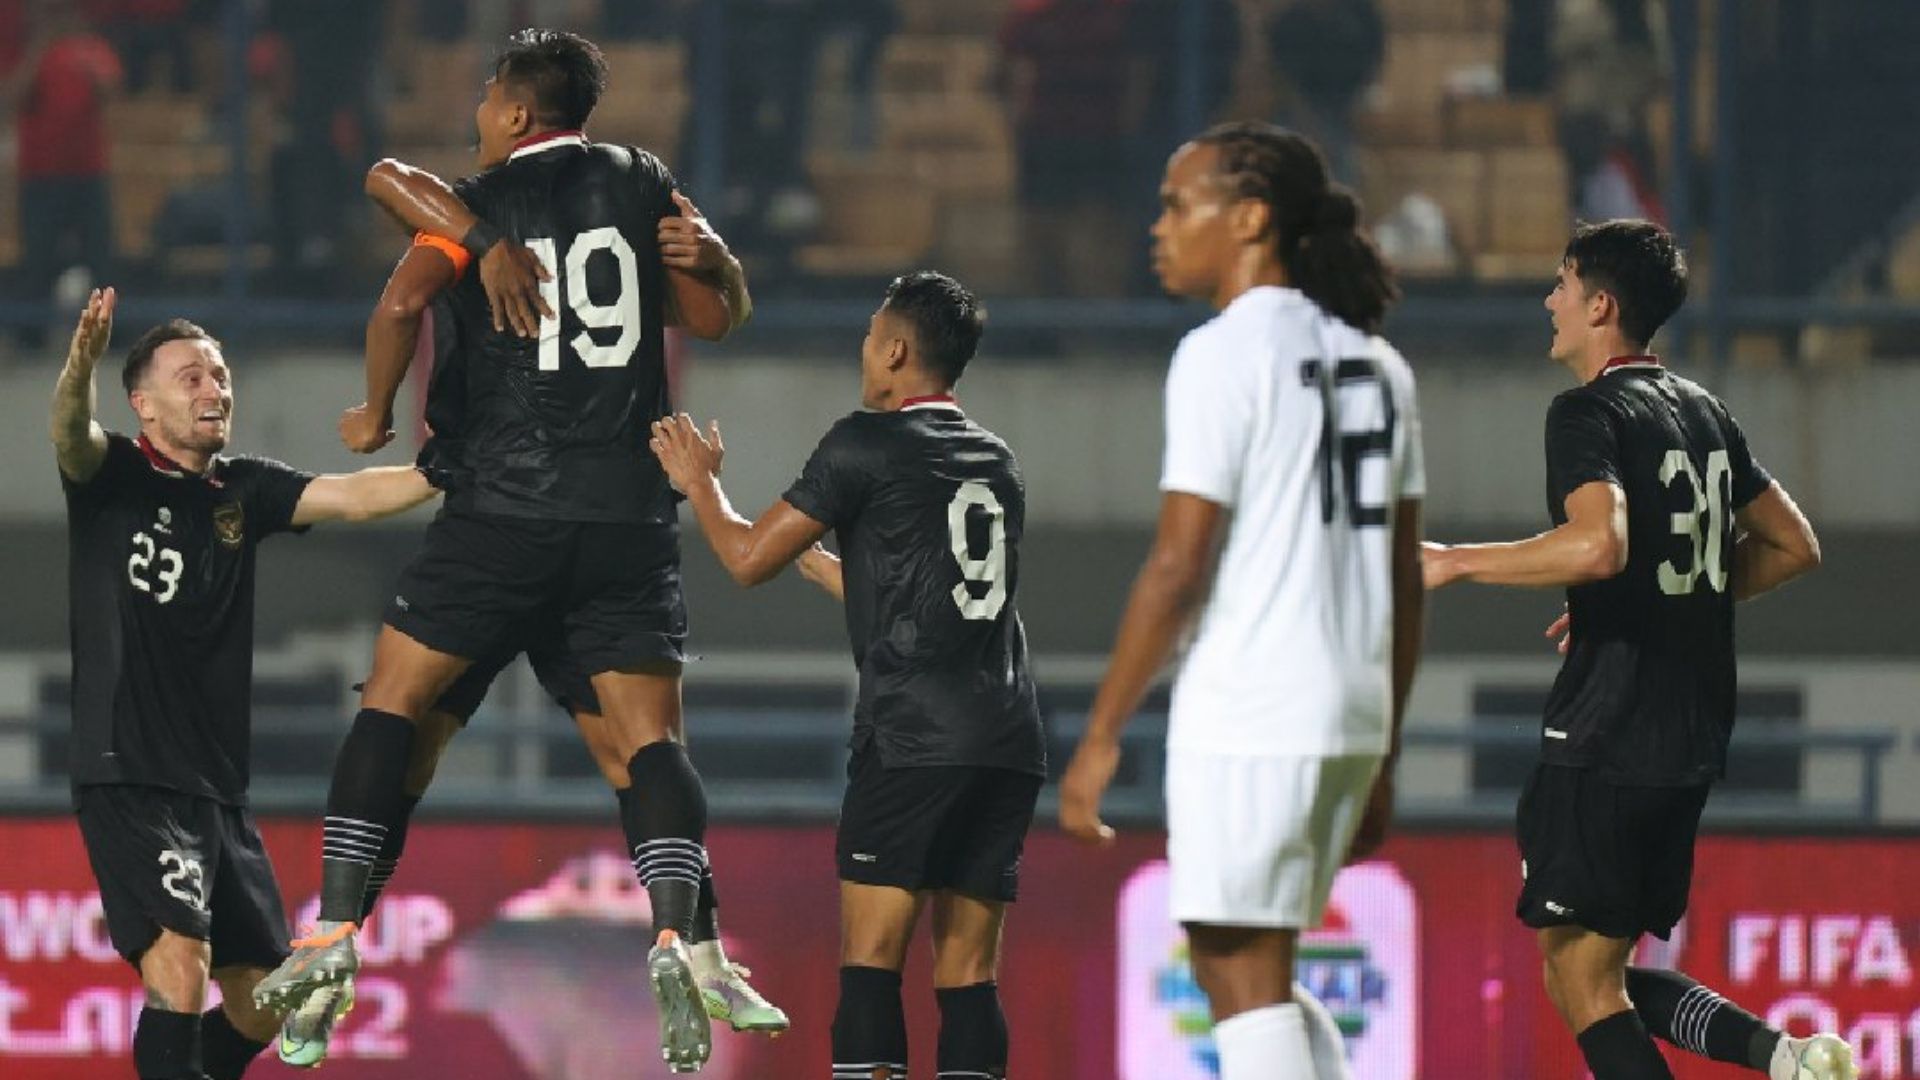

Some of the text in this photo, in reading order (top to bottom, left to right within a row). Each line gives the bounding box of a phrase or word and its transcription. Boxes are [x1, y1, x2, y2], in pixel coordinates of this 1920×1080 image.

[525, 227, 641, 371] 19
[1299, 359, 1396, 526] 12
[129, 532, 184, 604] 23
[948, 480, 1006, 620] 9
[1657, 449, 1735, 595] 30
[159, 849, 206, 911] 23
[1729, 914, 1913, 985] FIFA
